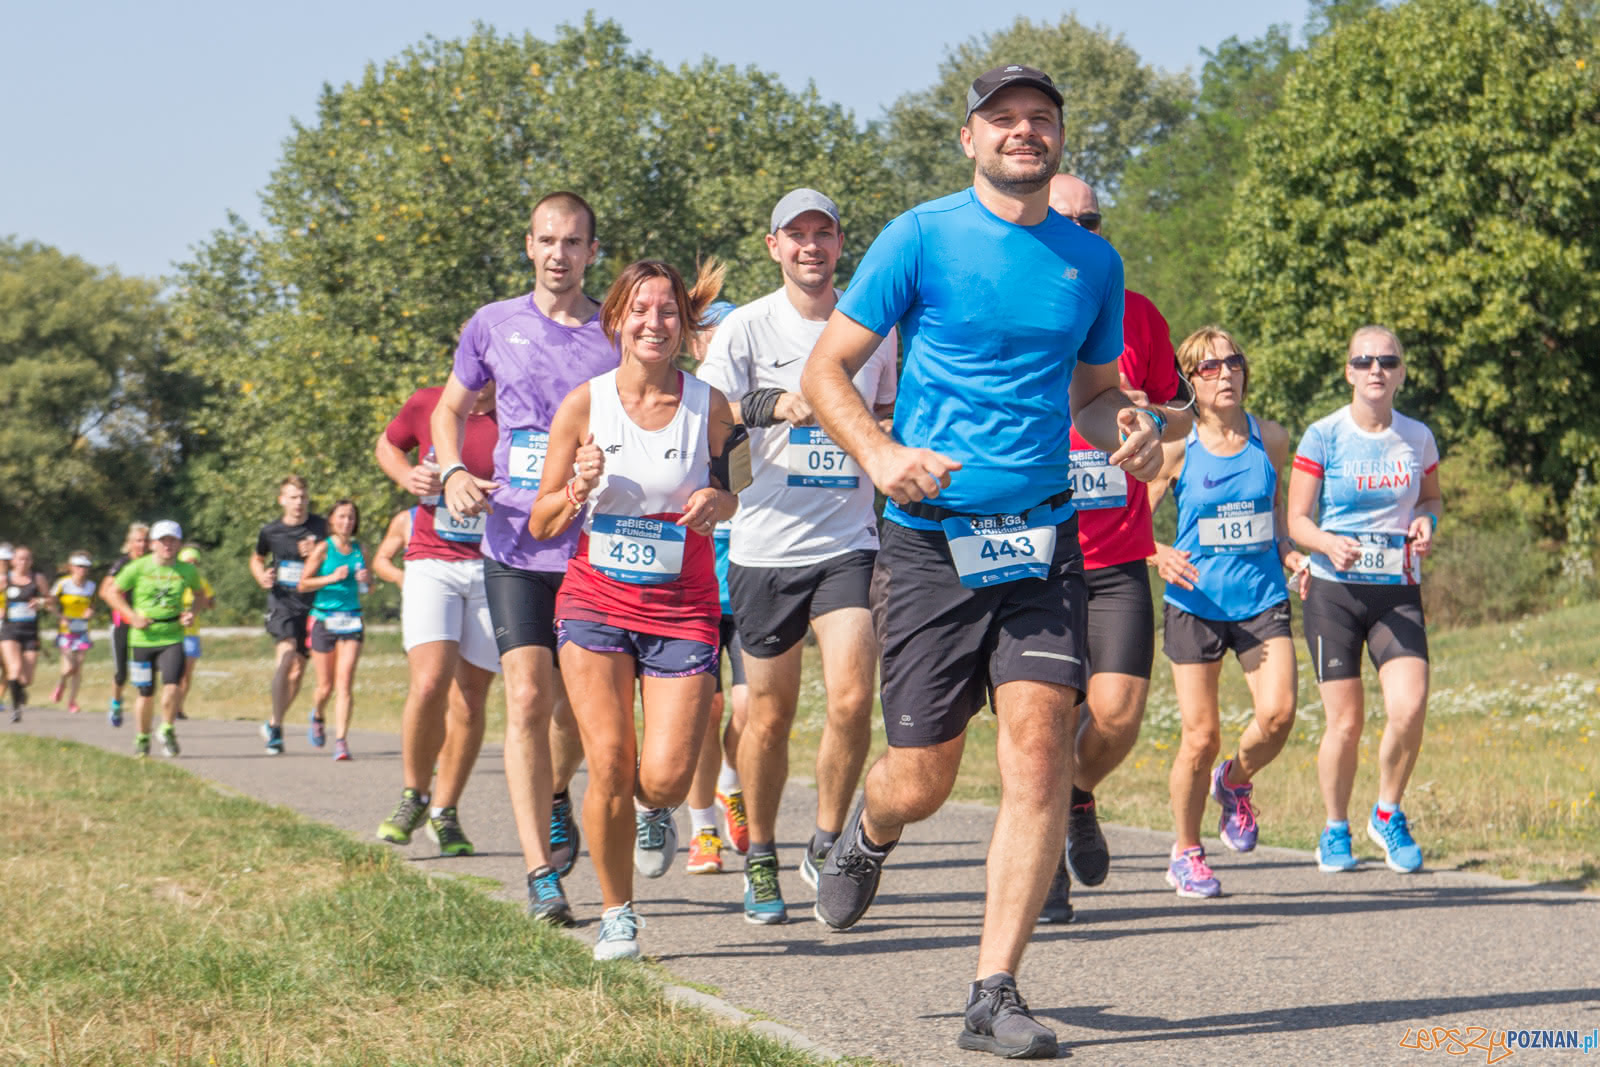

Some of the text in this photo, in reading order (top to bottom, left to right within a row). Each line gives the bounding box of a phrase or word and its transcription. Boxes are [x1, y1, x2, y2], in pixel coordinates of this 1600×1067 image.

[605, 445, 622, 454] 4F
[526, 454, 545, 473] 2
[808, 450, 848, 471] 057
[1071, 471, 1108, 493] 104
[1356, 474, 1411, 490] TEAM
[616, 519, 663, 532] zaBIEGaj
[1218, 519, 1253, 539] 181
[609, 541, 656, 566] 439
[981, 536, 1036, 561] 443
